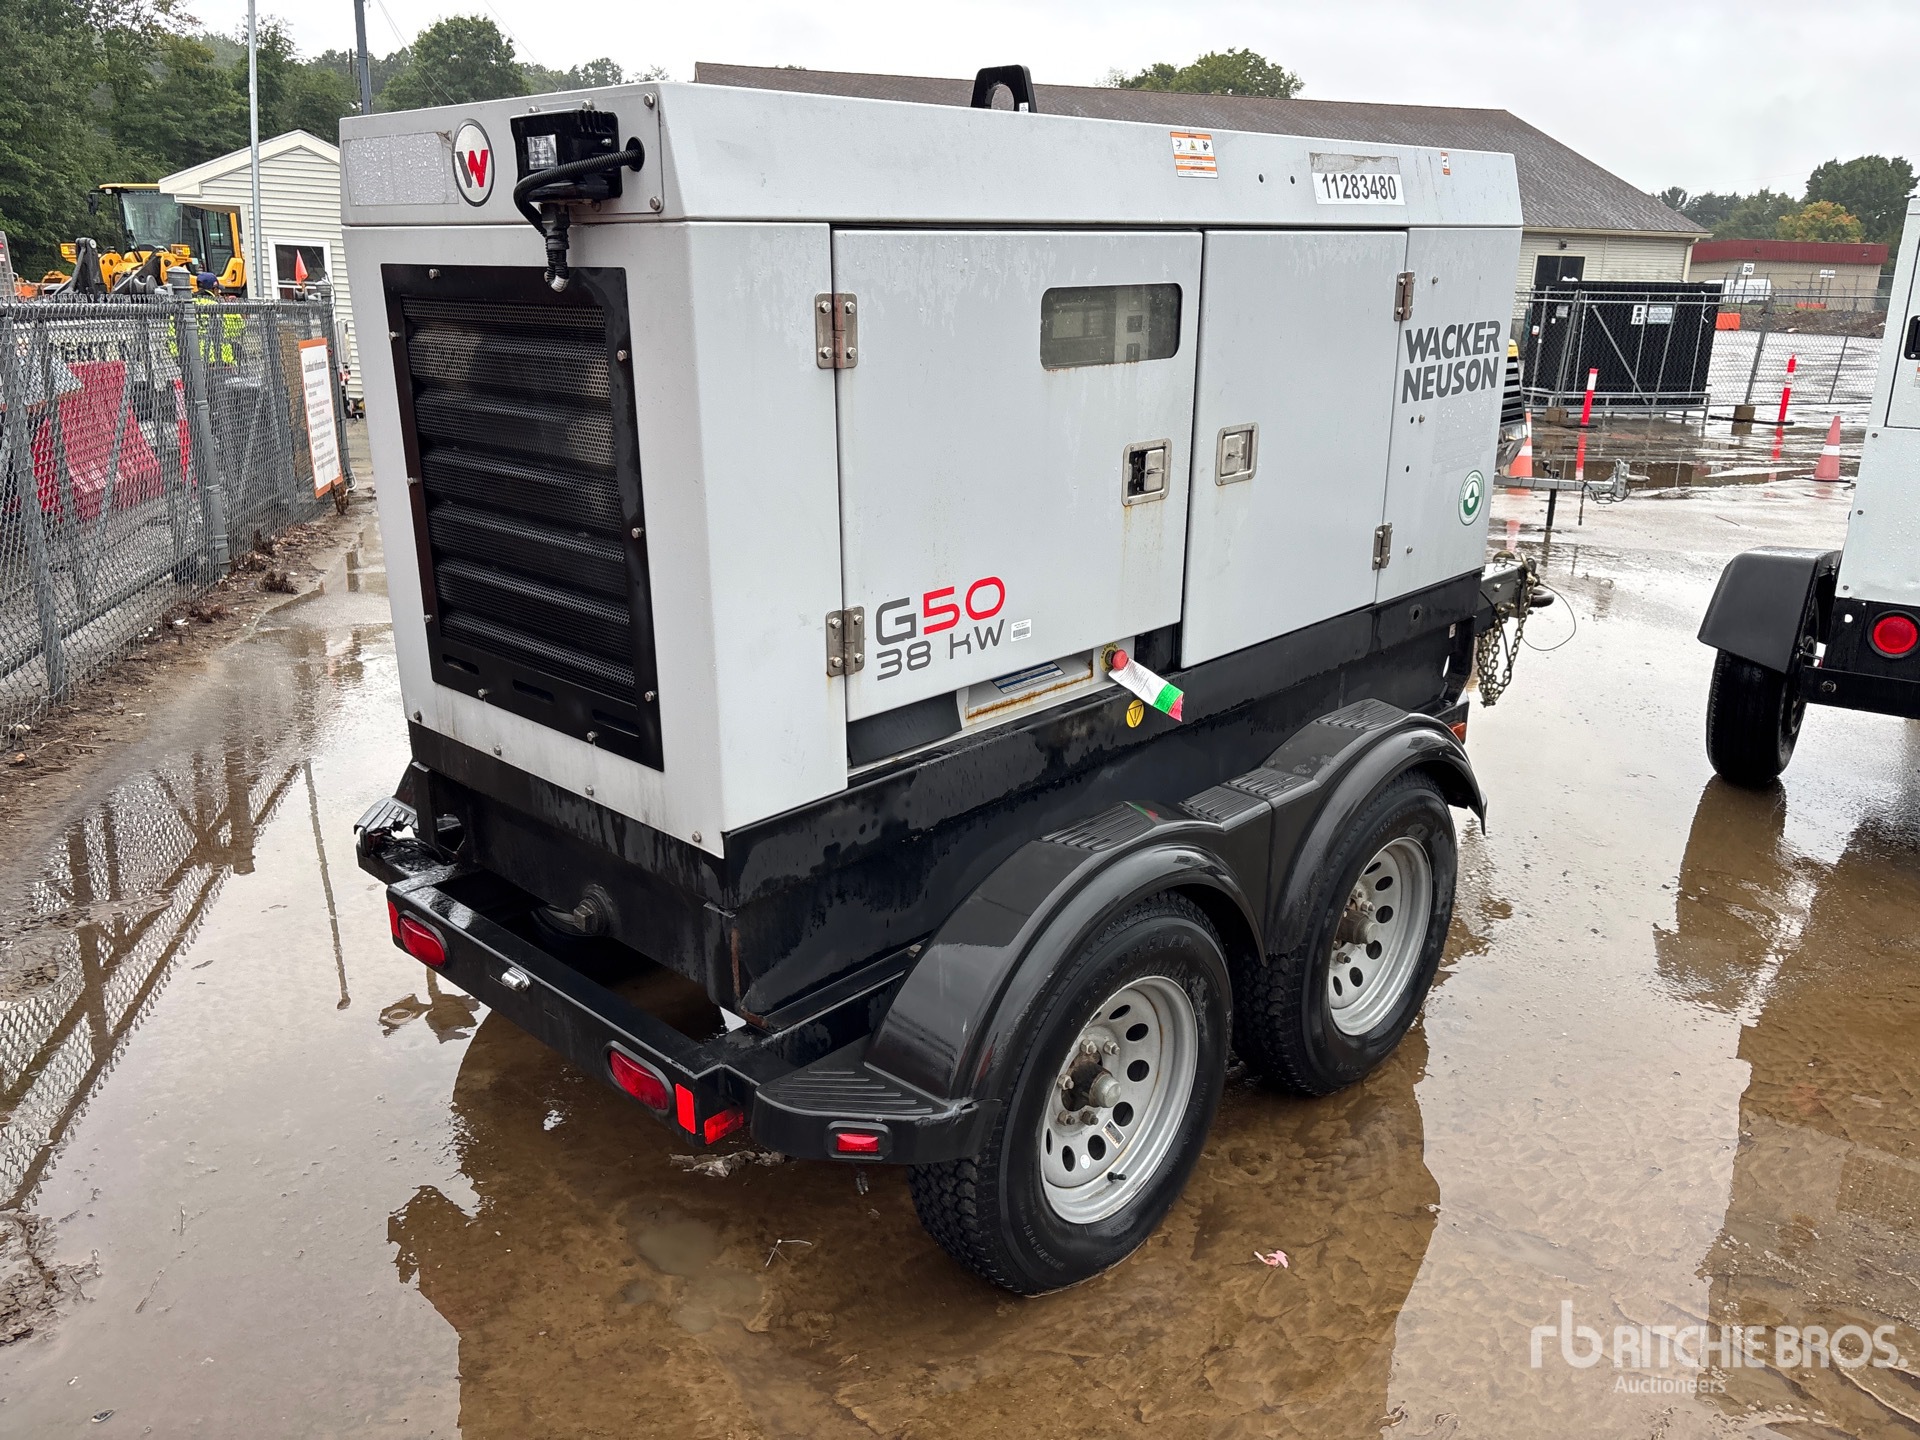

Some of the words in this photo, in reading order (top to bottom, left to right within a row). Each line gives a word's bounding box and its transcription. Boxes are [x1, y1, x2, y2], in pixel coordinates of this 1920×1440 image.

[1322, 173, 1397, 200] 11283480
[1405, 320, 1501, 364] WACKER
[1402, 356, 1499, 404] NEUSON
[876, 576, 1006, 646] G50
[876, 640, 932, 681] 38
